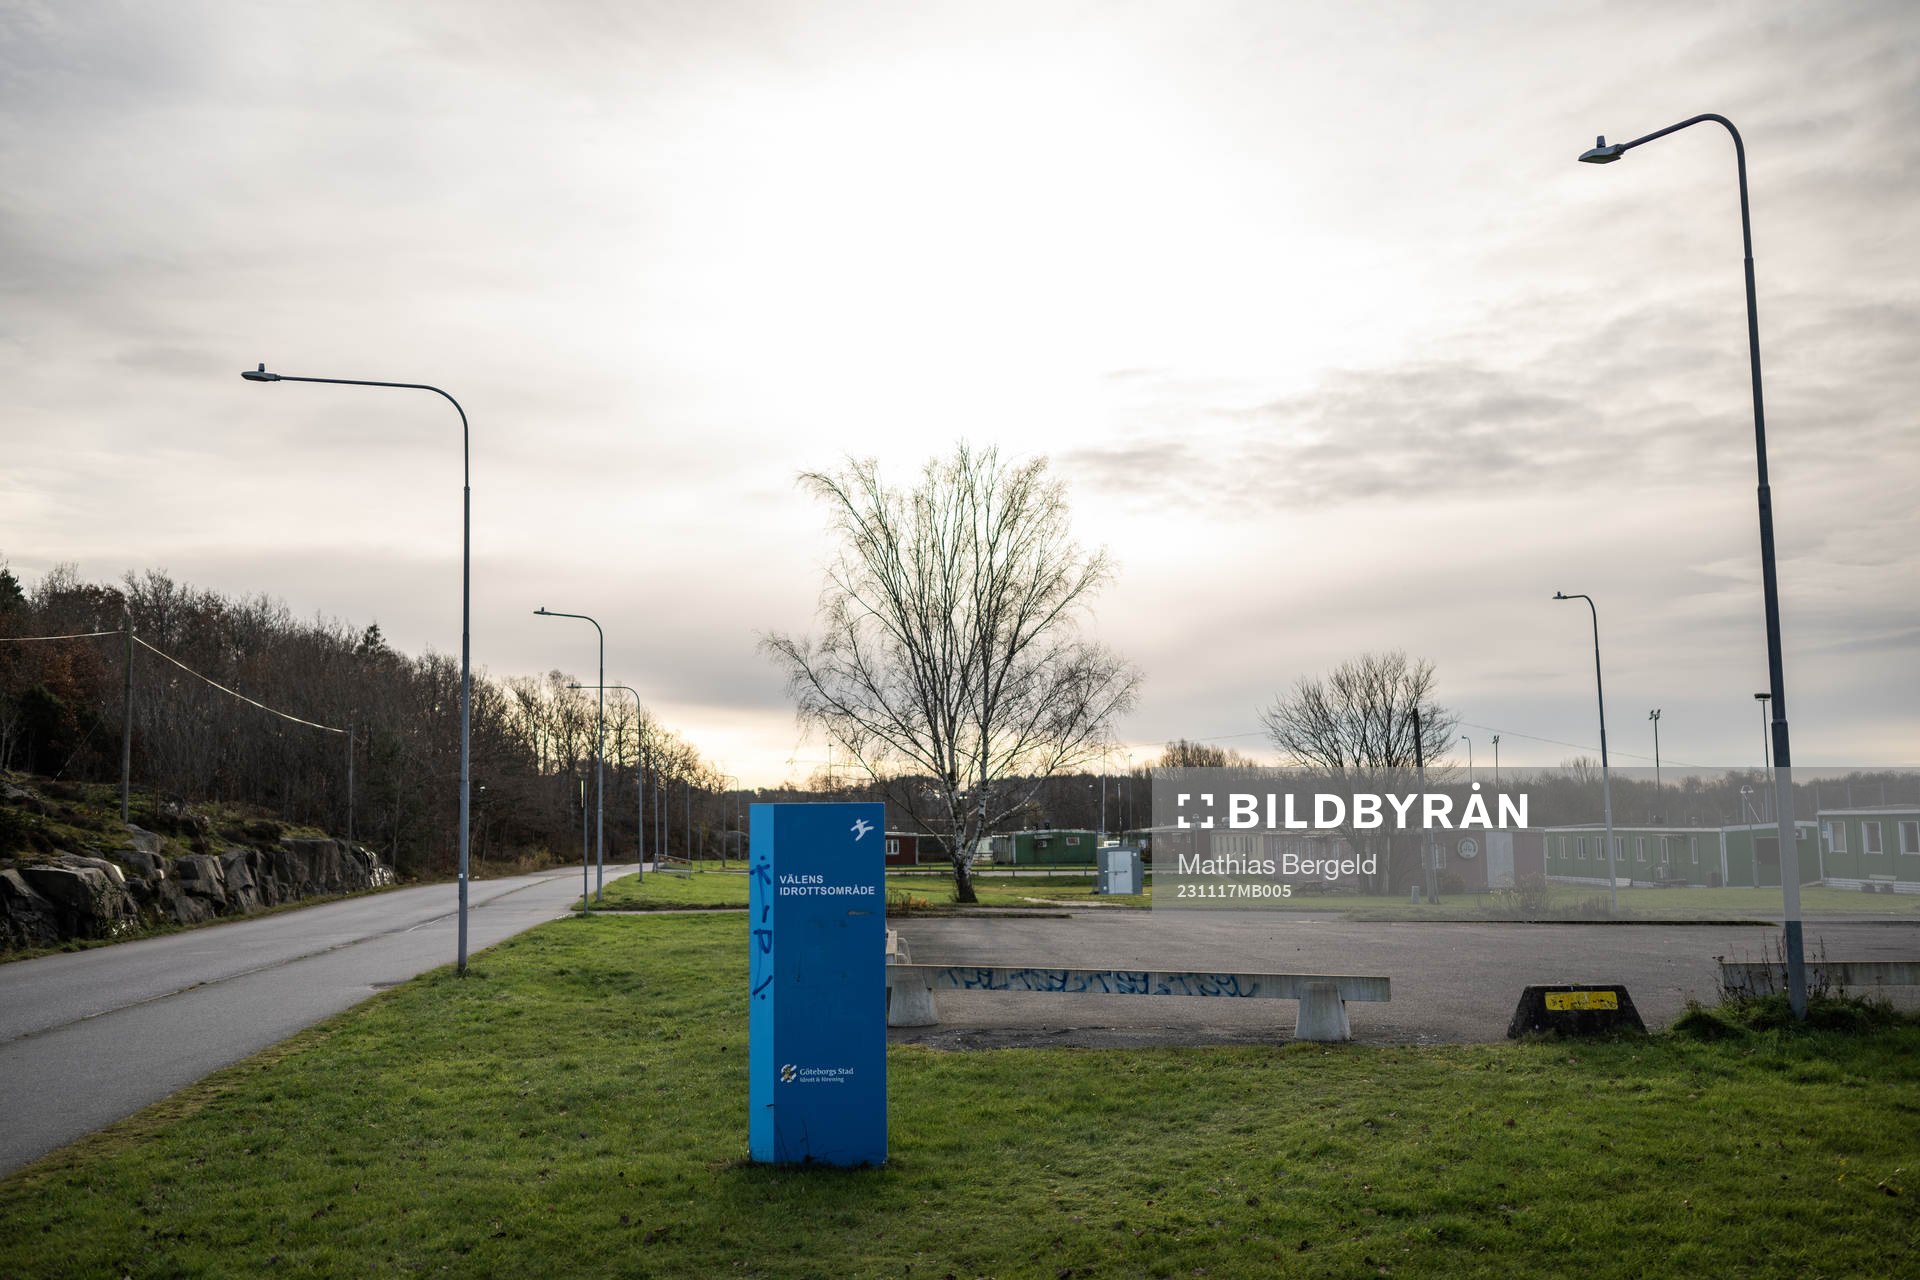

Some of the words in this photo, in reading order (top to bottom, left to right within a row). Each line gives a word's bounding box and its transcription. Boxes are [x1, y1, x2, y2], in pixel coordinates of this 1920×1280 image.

[779, 873, 824, 884] VÄLENS
[779, 884, 875, 896] IDROTTSOMRÅDE
[799, 1067, 837, 1076] Göteborgs
[838, 1067, 854, 1075] Stad
